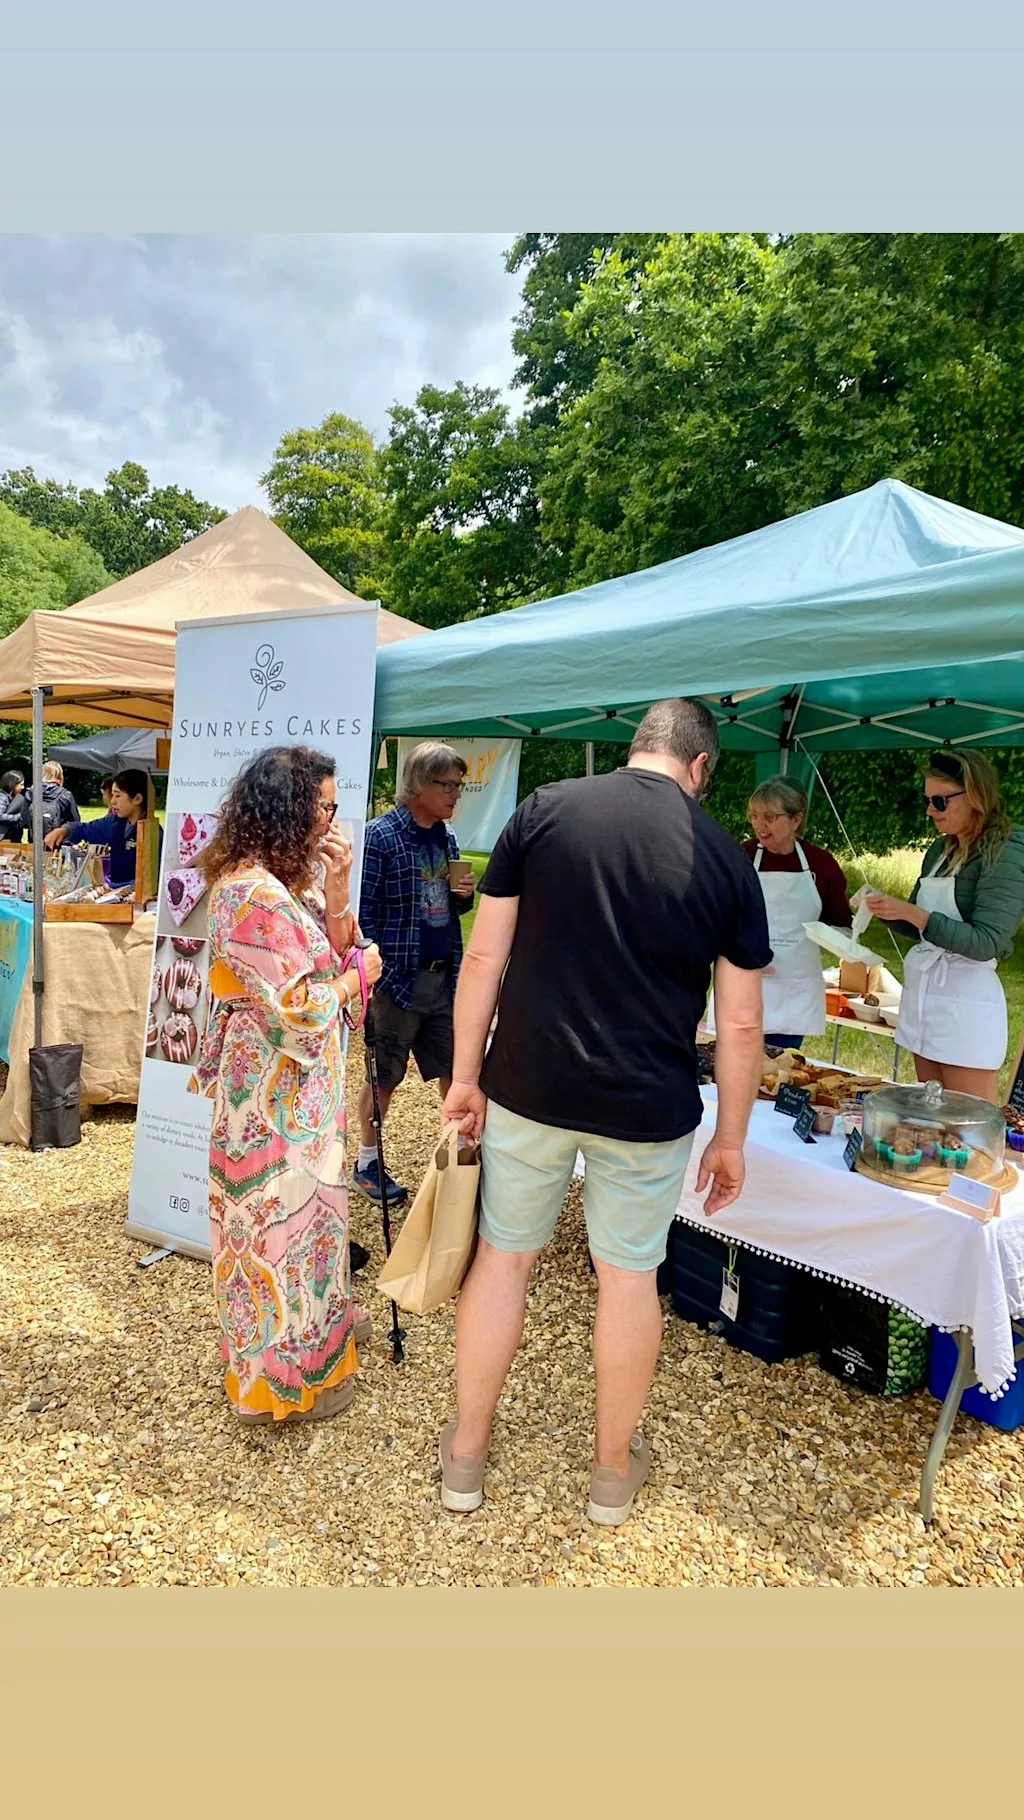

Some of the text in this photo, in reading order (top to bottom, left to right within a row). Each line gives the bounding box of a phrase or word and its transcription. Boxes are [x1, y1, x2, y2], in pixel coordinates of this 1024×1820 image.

[180, 715, 361, 738] SUNRYES CAKES
[173, 776, 209, 787] Wholesome
[211, 777, 218, 788] &
[337, 778, 362, 790] Cakes
